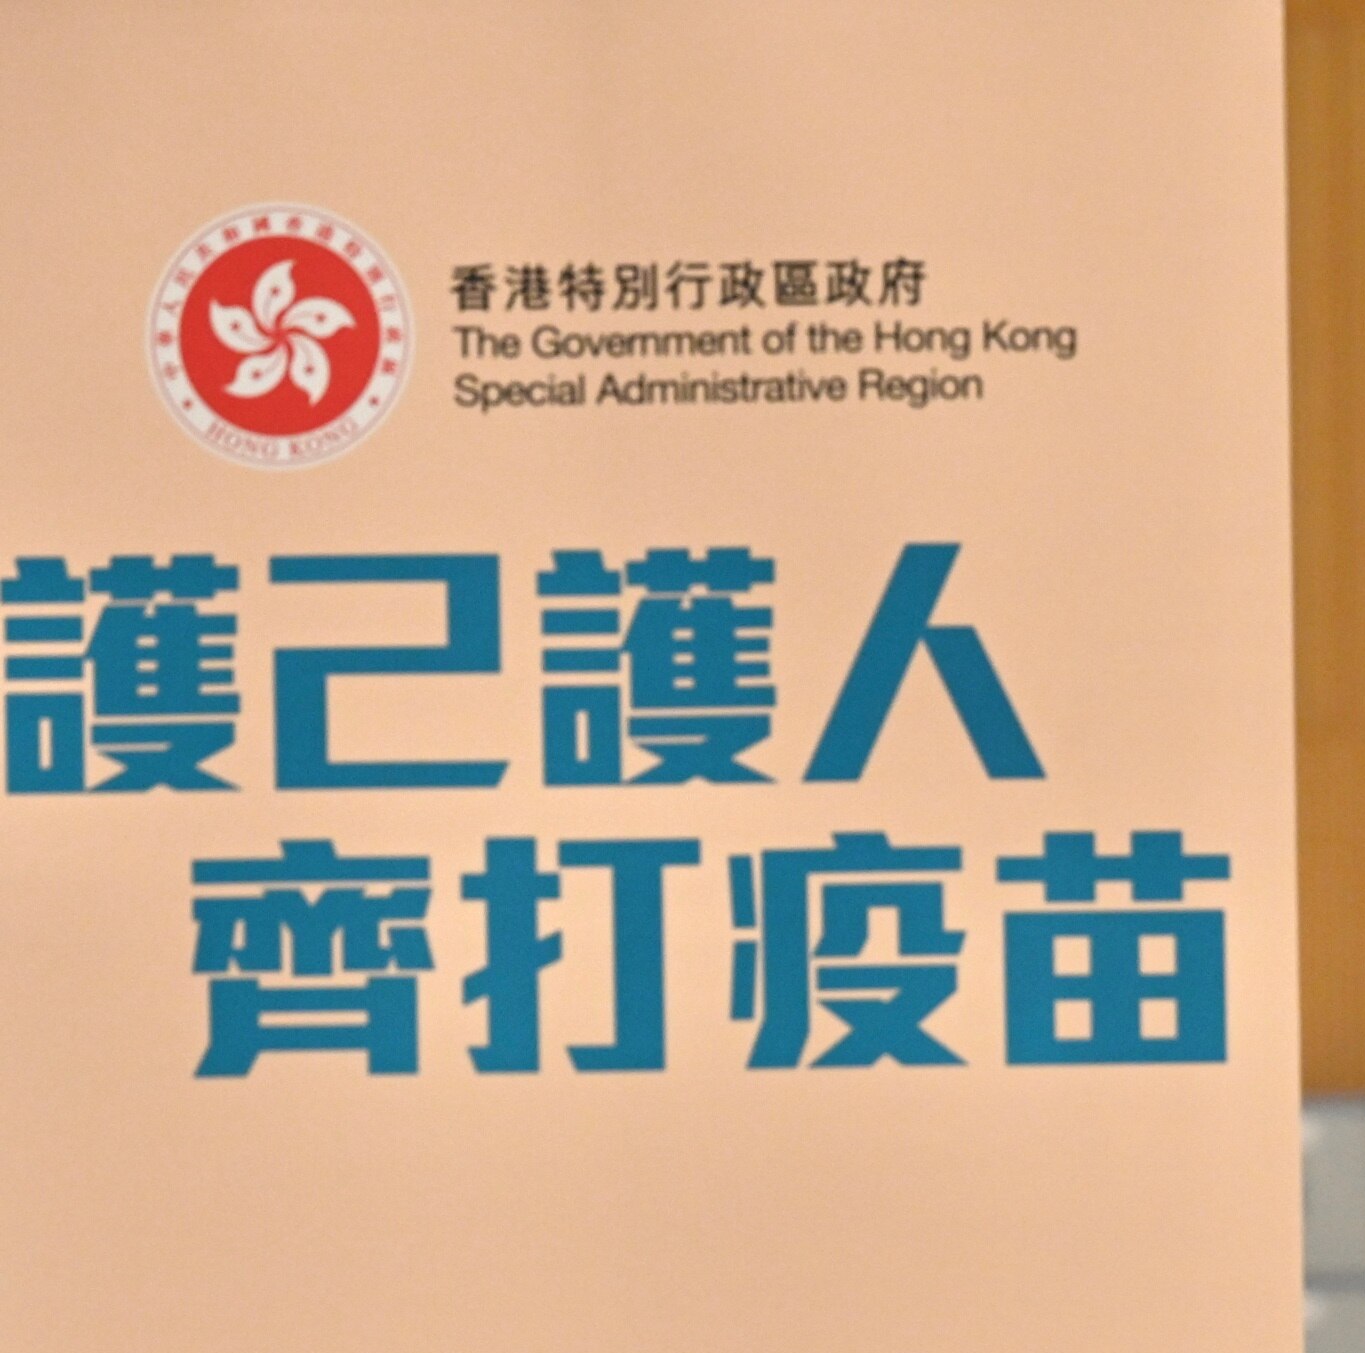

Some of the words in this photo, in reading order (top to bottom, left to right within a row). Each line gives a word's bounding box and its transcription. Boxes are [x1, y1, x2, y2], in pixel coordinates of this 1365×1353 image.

[450, 257, 928, 312] 香港特別行政區政府
[453, 324, 520, 359] The
[530, 323, 751, 360] Government
[761, 320, 797, 356] of
[807, 320, 863, 353] the
[873, 320, 971, 360] Hong
[981, 319, 1078, 362] Kong
[453, 373, 586, 414] Special
[595, 367, 847, 407] Administrative
[857, 367, 983, 410] Region
[0, 542, 1049, 795] 護己護人
[191, 830, 1231, 1079] 齊打疫苗
